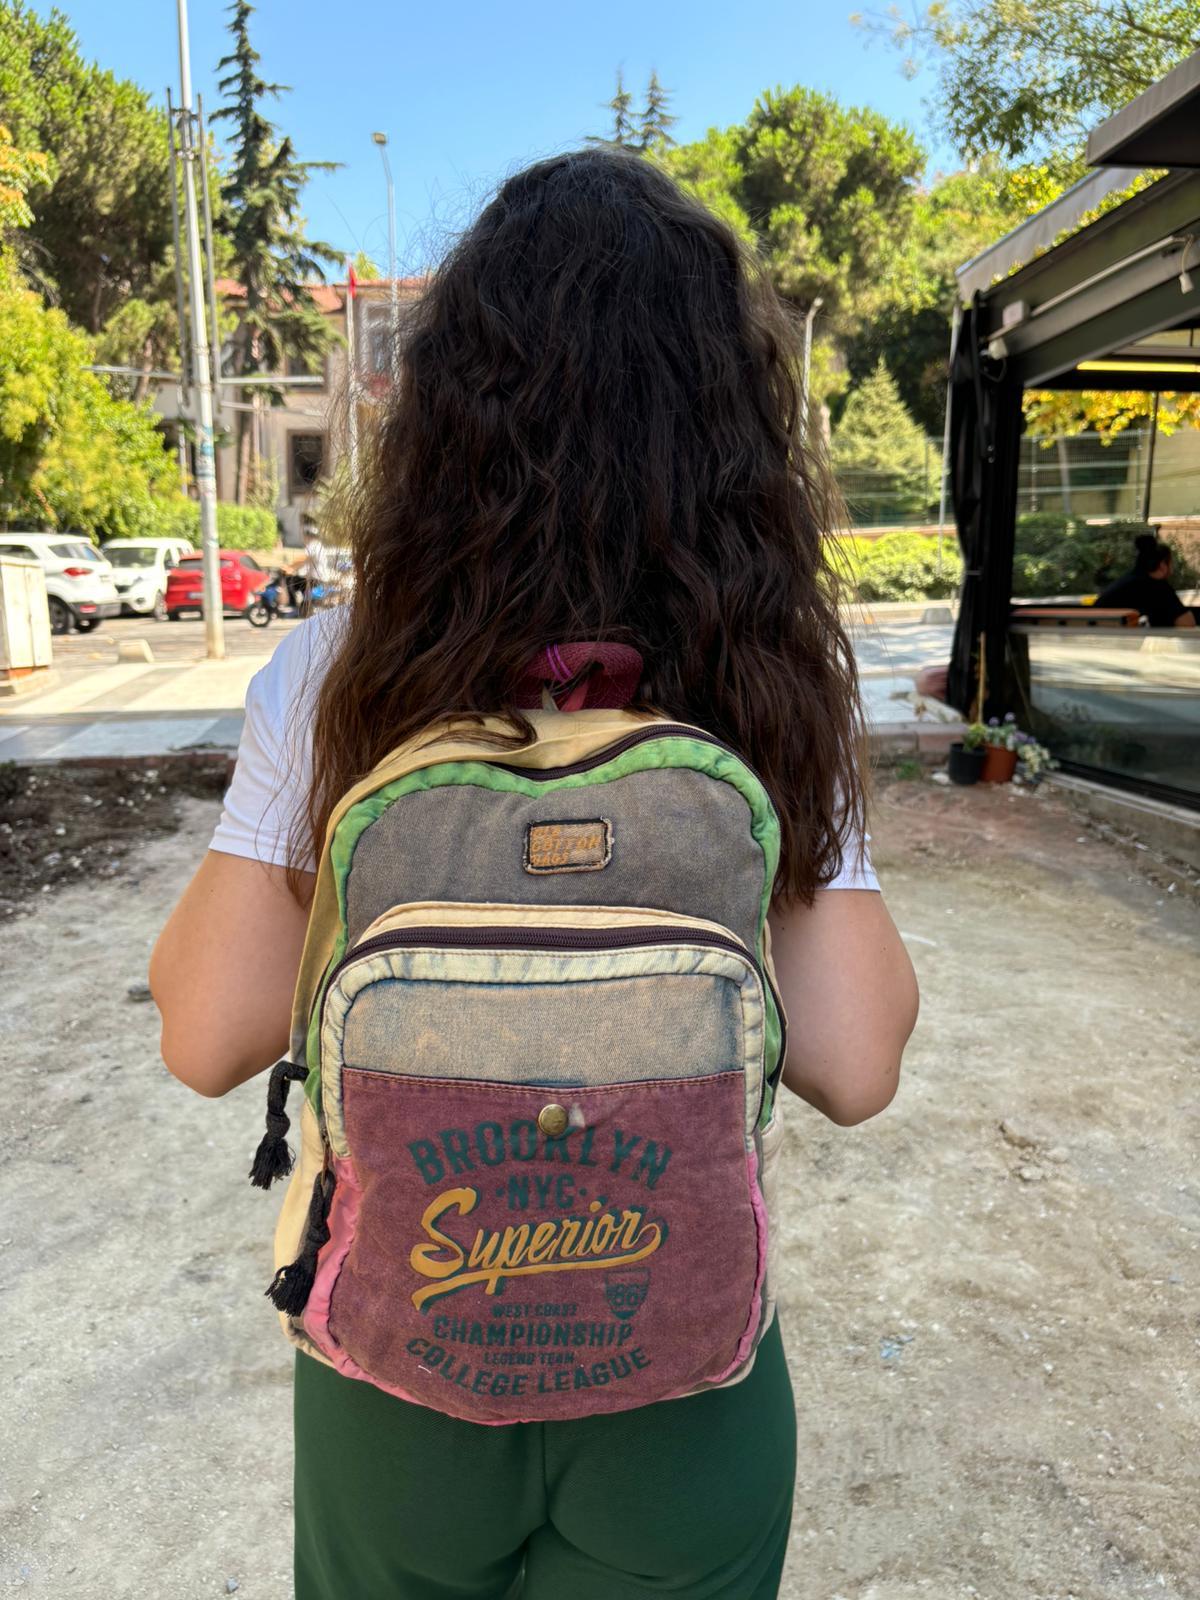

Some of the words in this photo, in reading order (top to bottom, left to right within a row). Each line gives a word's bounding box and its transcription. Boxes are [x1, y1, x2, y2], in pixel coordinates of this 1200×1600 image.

[407, 1119, 673, 1190] BROOKLYN
[410, 1187, 669, 1314] Superior
[433, 1315, 633, 1347] CHAMPIONSHIP
[492, 1303, 529, 1318] WEST
[406, 1337, 529, 1397] COLLEGE
[537, 1347, 653, 1394] LEAGUE
[483, 1352, 535, 1366] LEGEND
[540, 1351, 575, 1365] TEAM
